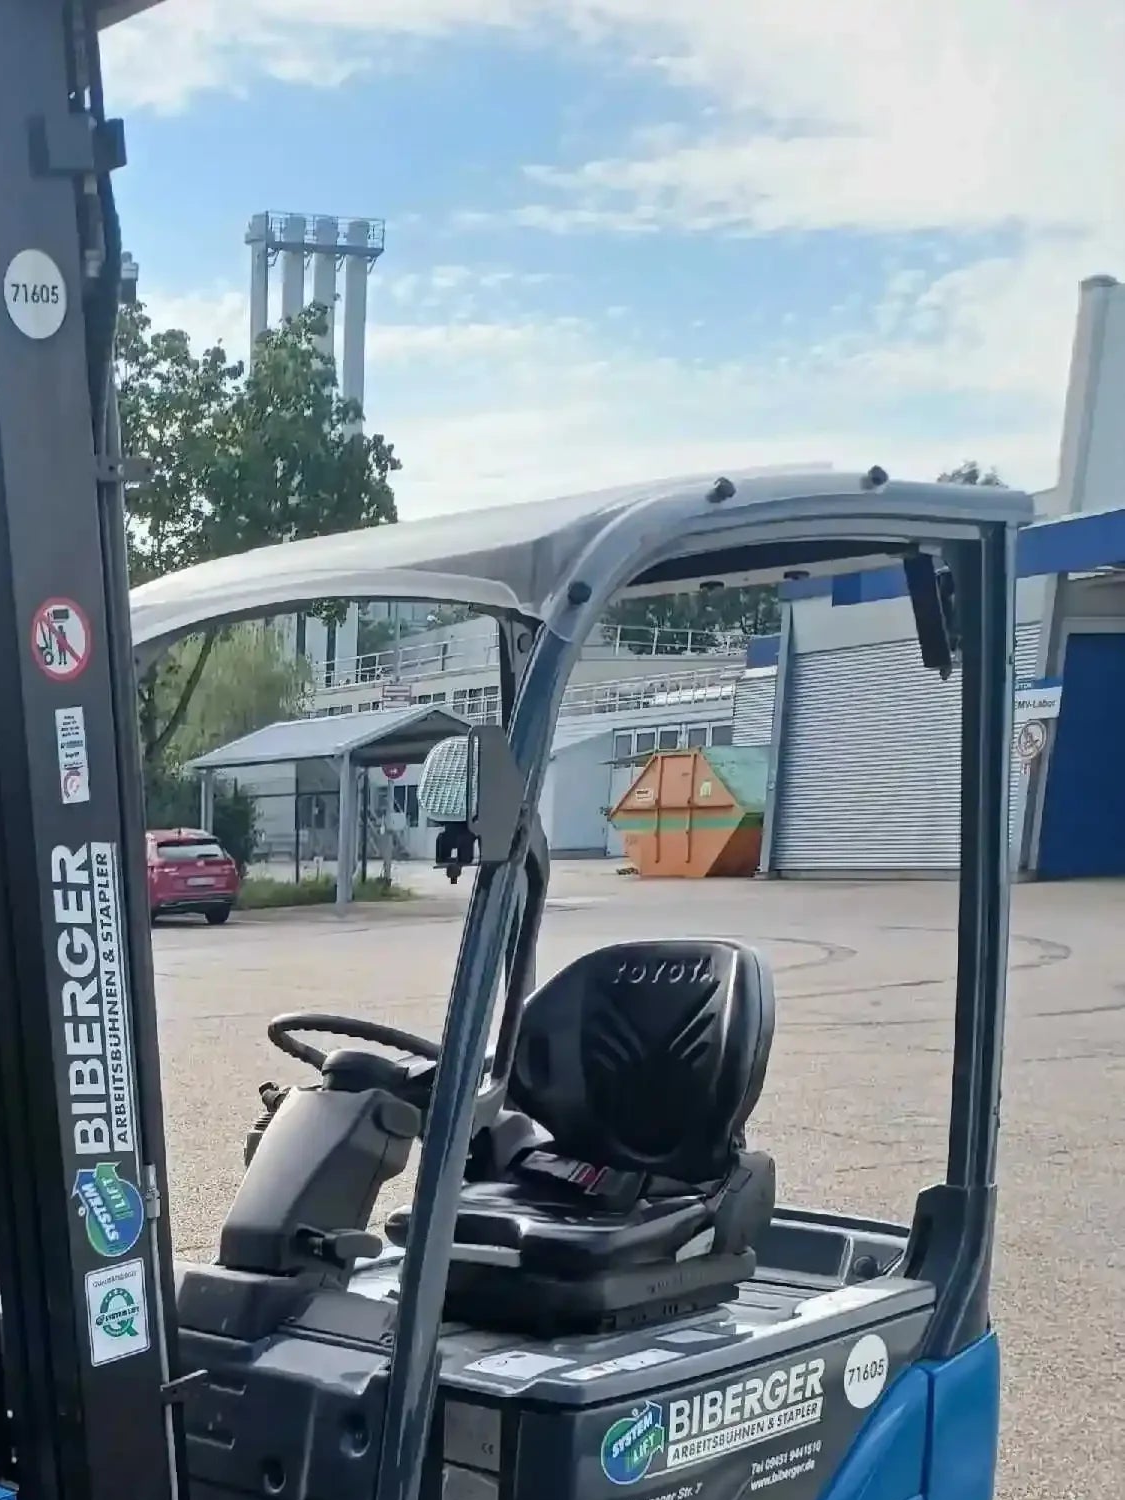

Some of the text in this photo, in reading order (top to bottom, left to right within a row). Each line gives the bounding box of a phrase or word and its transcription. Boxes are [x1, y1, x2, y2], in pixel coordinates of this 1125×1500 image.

[10, 283, 59, 304] 71605
[612, 957, 716, 984] TOYOTA
[51, 842, 111, 1155] BIBERGER
[95, 853, 129, 1144] ARBEITSBÜHNEN & STAPLER
[81, 1182, 120, 1242] SYSTEM
[101, 1177, 126, 1209] LIFT
[848, 1358, 885, 1386] 71605
[668, 1358, 825, 1442] BIBERGER
[612, 1411, 653, 1458] SYSTEM
[633, 1432, 655, 1463] LIFT
[672, 1402, 818, 1461] ARBEITSBÜHNEN & STAPLER
[750, 1458, 815, 1491] www.biberger.de
